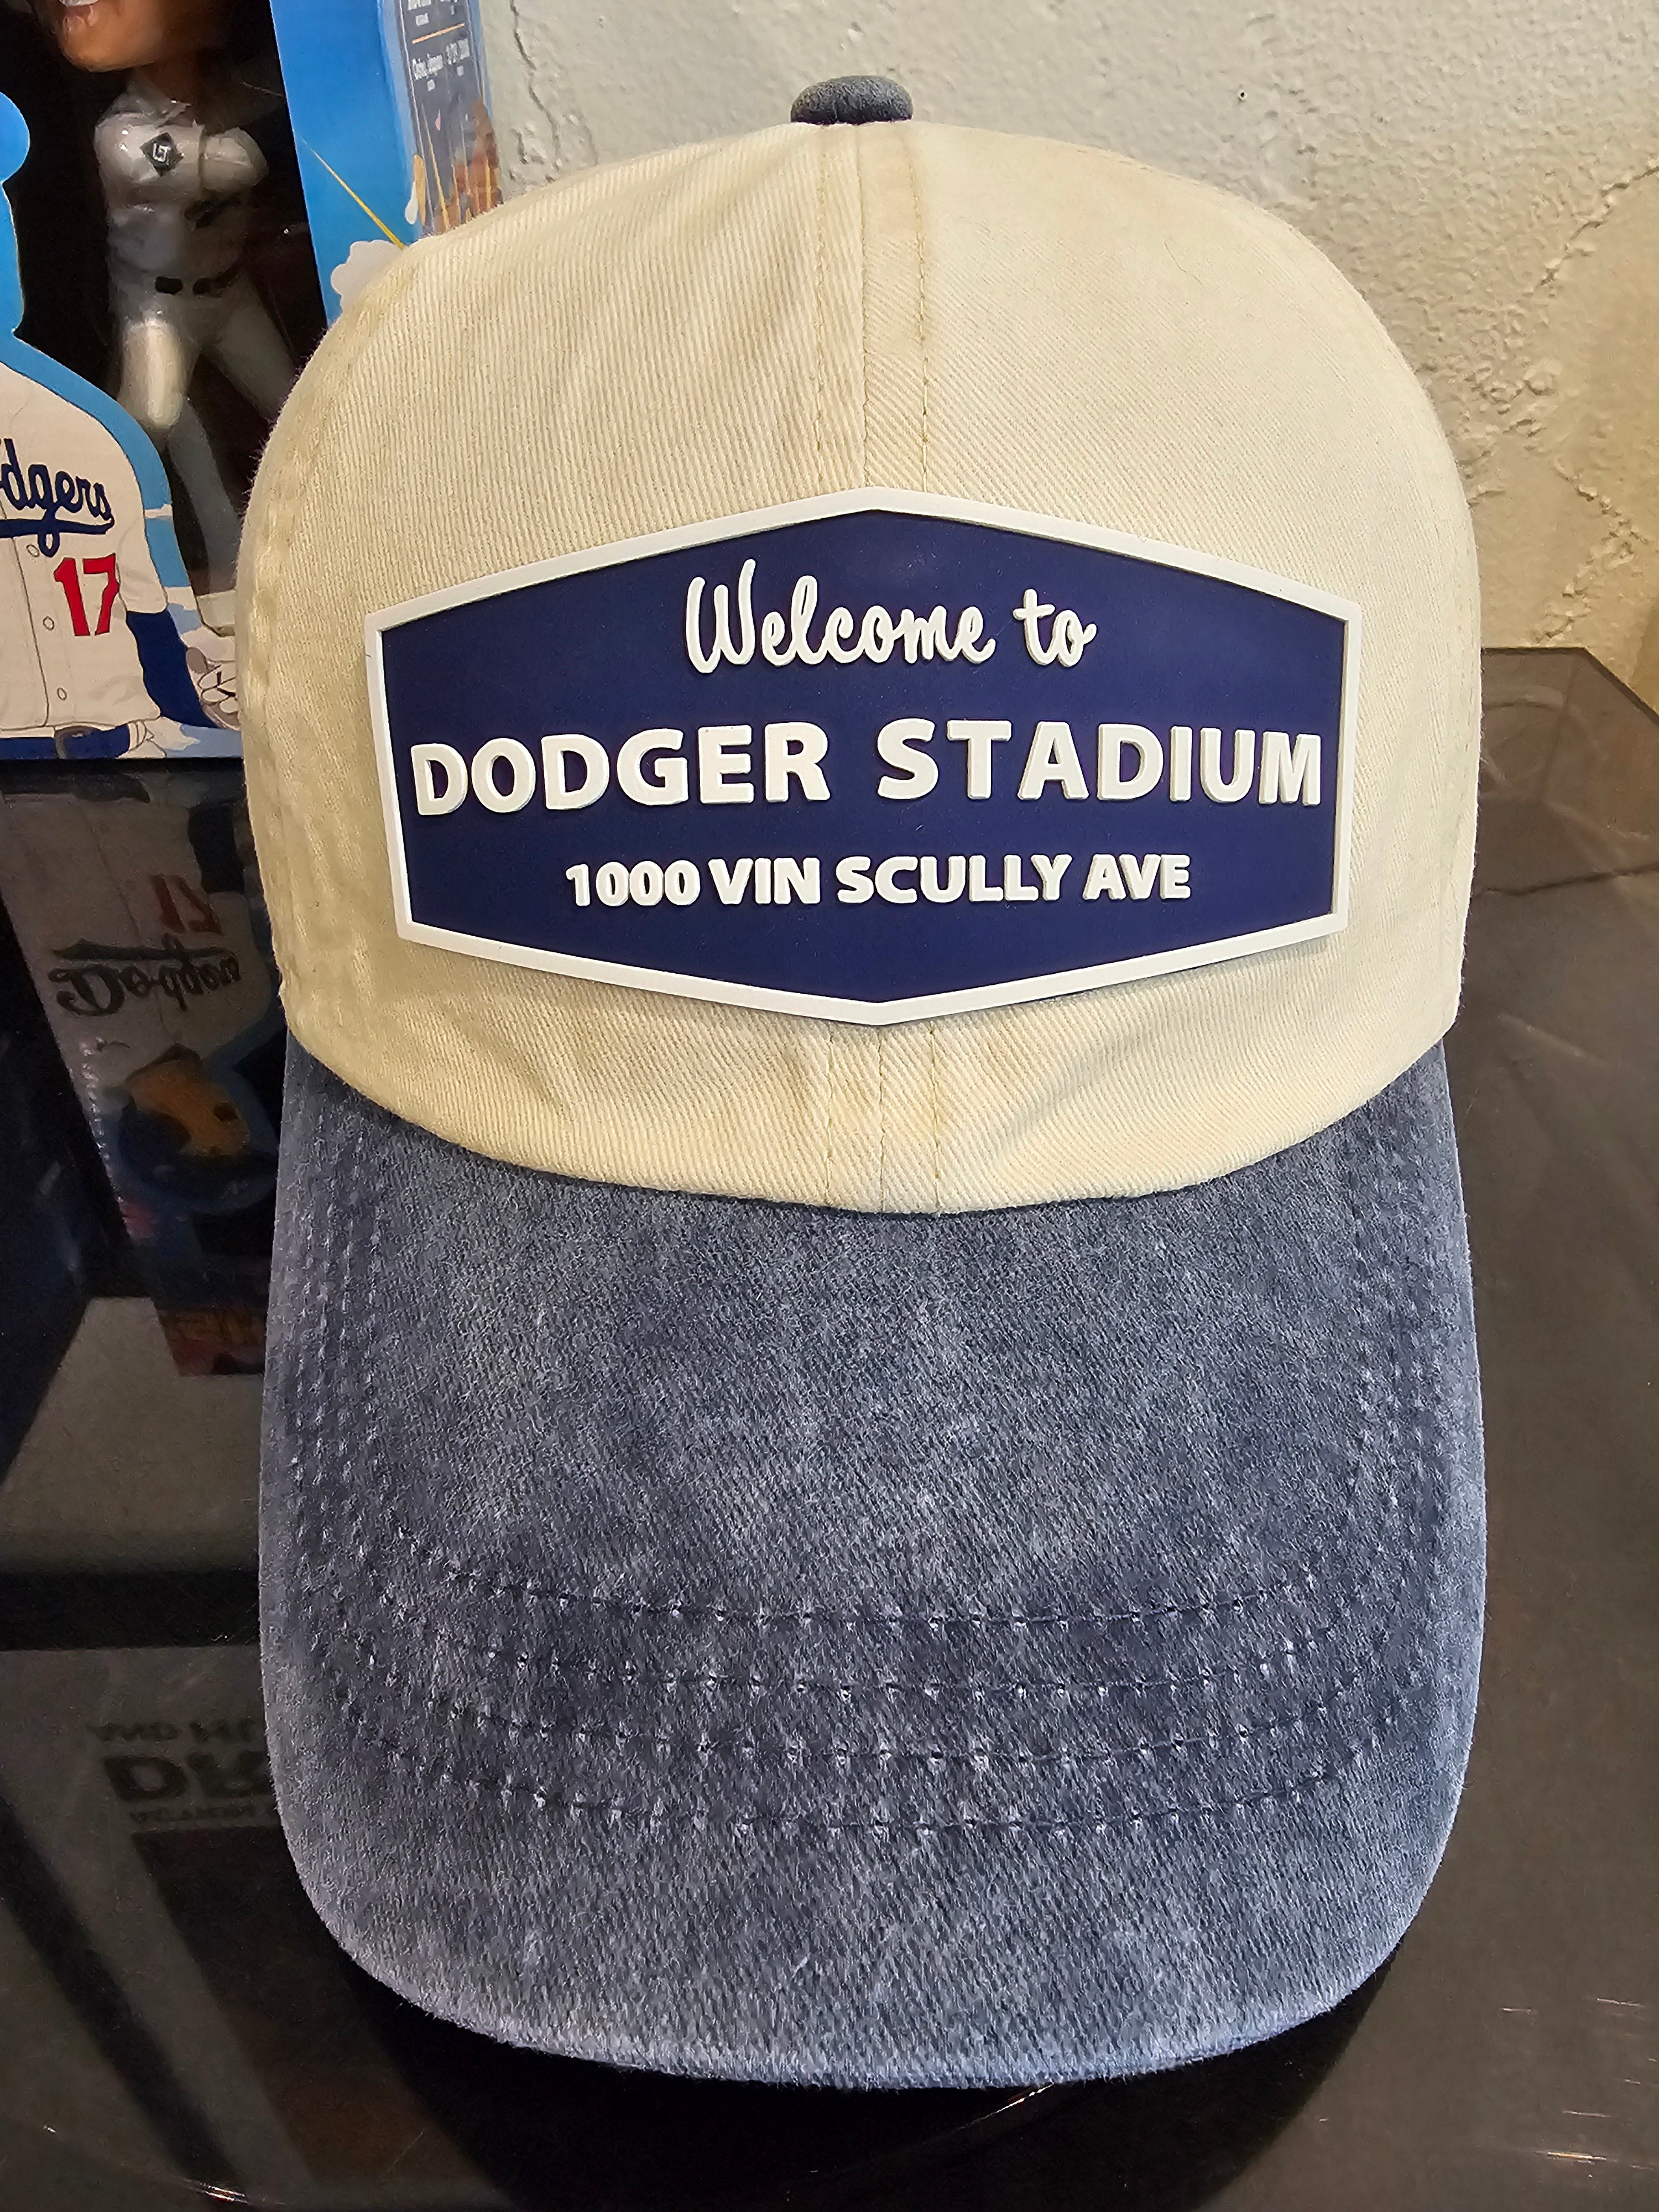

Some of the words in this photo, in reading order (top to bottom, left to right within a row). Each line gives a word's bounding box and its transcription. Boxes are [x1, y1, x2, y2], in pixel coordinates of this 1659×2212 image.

[0, 438, 115, 557] dgers
[53, 553, 120, 637] 17
[685, 559, 997, 674] Welcome
[1013, 588, 1097, 667] to
[410, 722, 831, 816] DODGER
[877, 718, 1321, 806] STADIUM
[565, 859, 701, 906] 1000
[708, 856, 821, 905] VIN
[836, 854, 1072, 904] SCULLY
[1082, 854, 1191, 900] AVE
